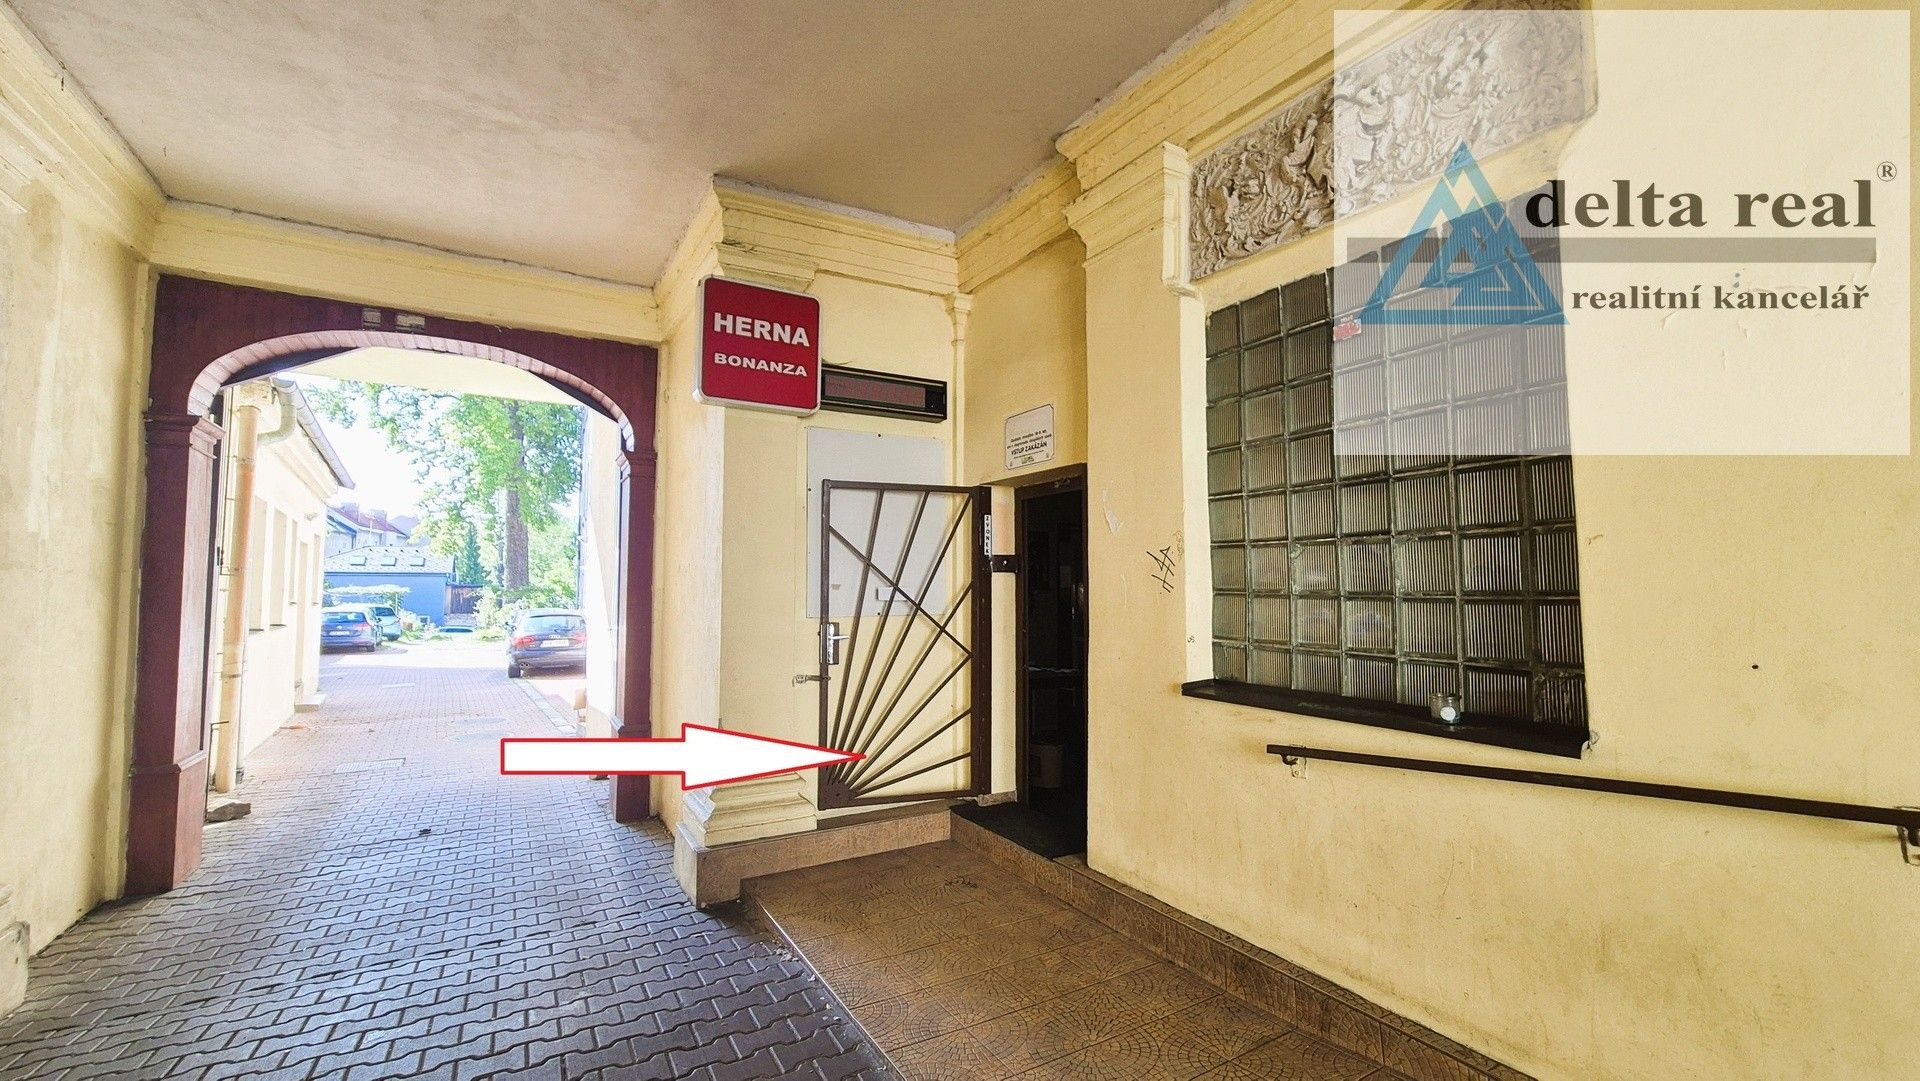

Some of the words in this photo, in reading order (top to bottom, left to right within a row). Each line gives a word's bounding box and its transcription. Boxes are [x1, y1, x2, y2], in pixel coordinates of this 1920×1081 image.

[713, 312, 810, 347] HERNA
[714, 352, 808, 377] BONANZA
[1011, 447, 1025, 455] VSTUP
[1025, 440, 1048, 453] ZAKÁZÁN
